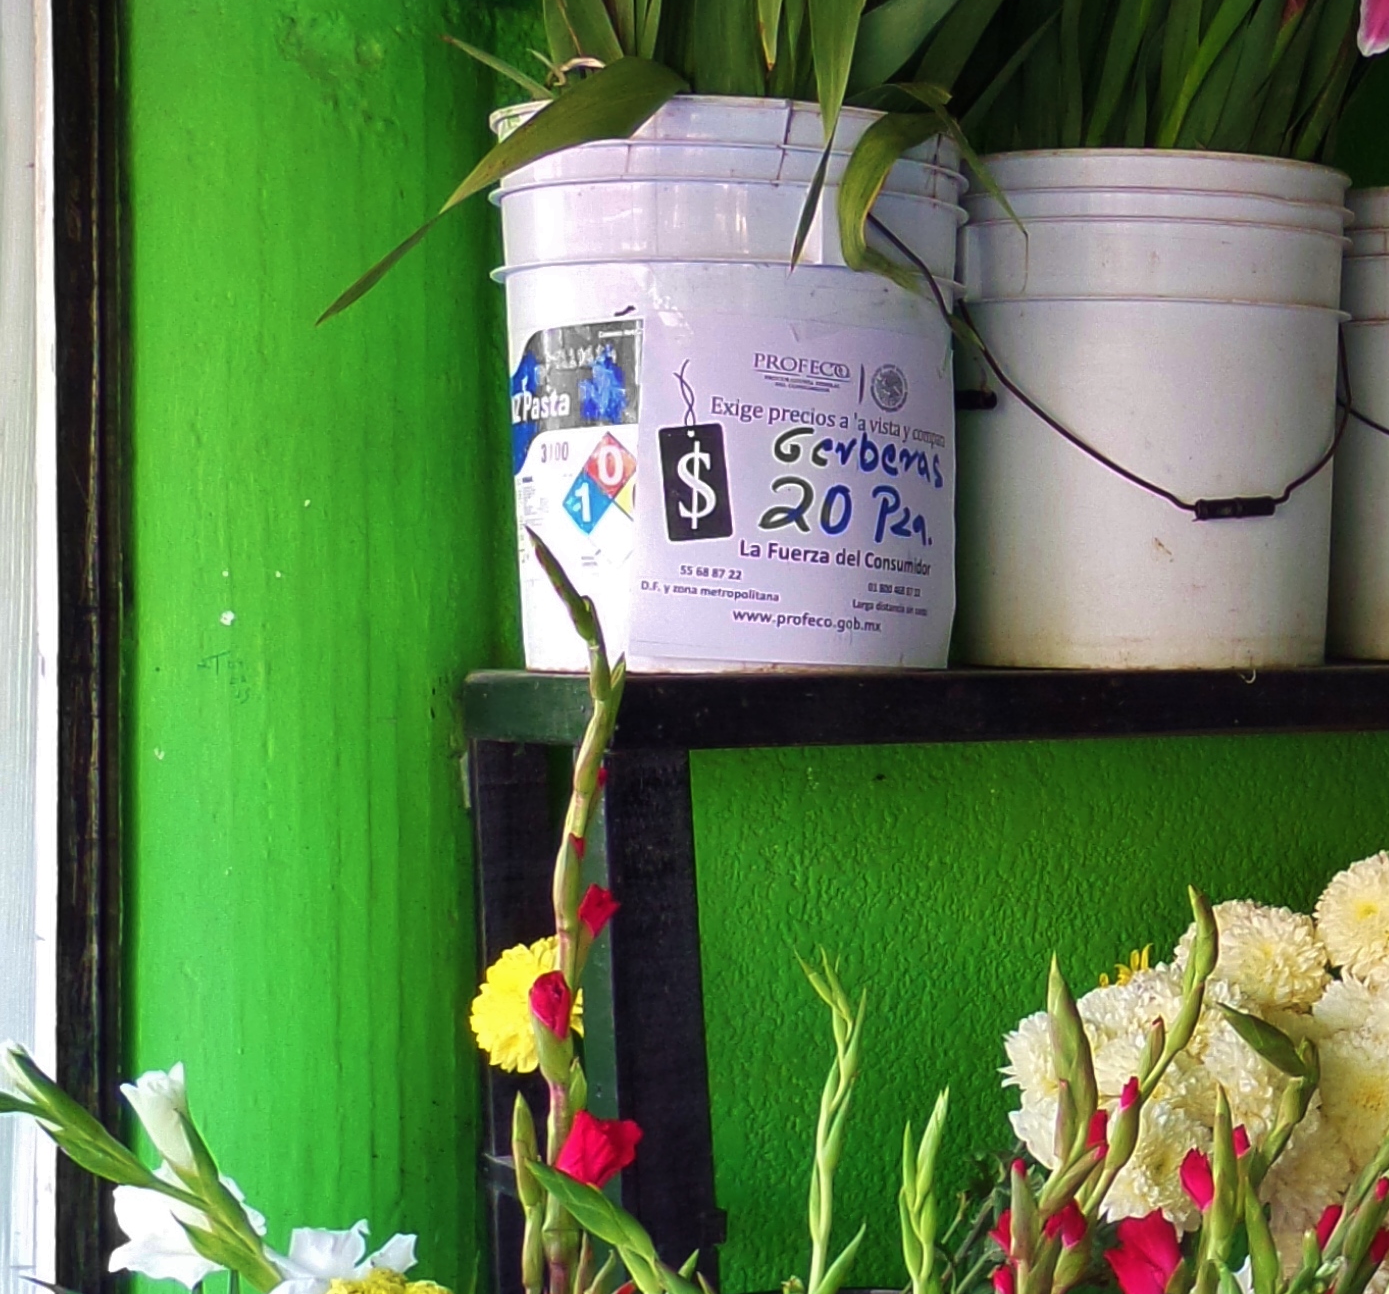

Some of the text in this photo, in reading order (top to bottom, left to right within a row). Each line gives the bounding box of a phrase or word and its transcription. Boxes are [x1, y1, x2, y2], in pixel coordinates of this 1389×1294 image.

[754, 352, 851, 379] PROFECO
[523, 390, 571, 419] Pasta
[711, 396, 763, 422] Exige
[768, 406, 835, 428] precios
[839, 415, 849, 428] a
[869, 417, 900, 437] vista
[902, 424, 911, 443] y
[757, 475, 852, 535] 20
[740, 539, 932, 576] La Fuerza del Consumidor
[680, 565, 742, 581] 55 68 87 22
[641, 580, 779, 602] D.F. y zona metropolitana
[733, 610, 882, 633] www.profeco.gob.mx
